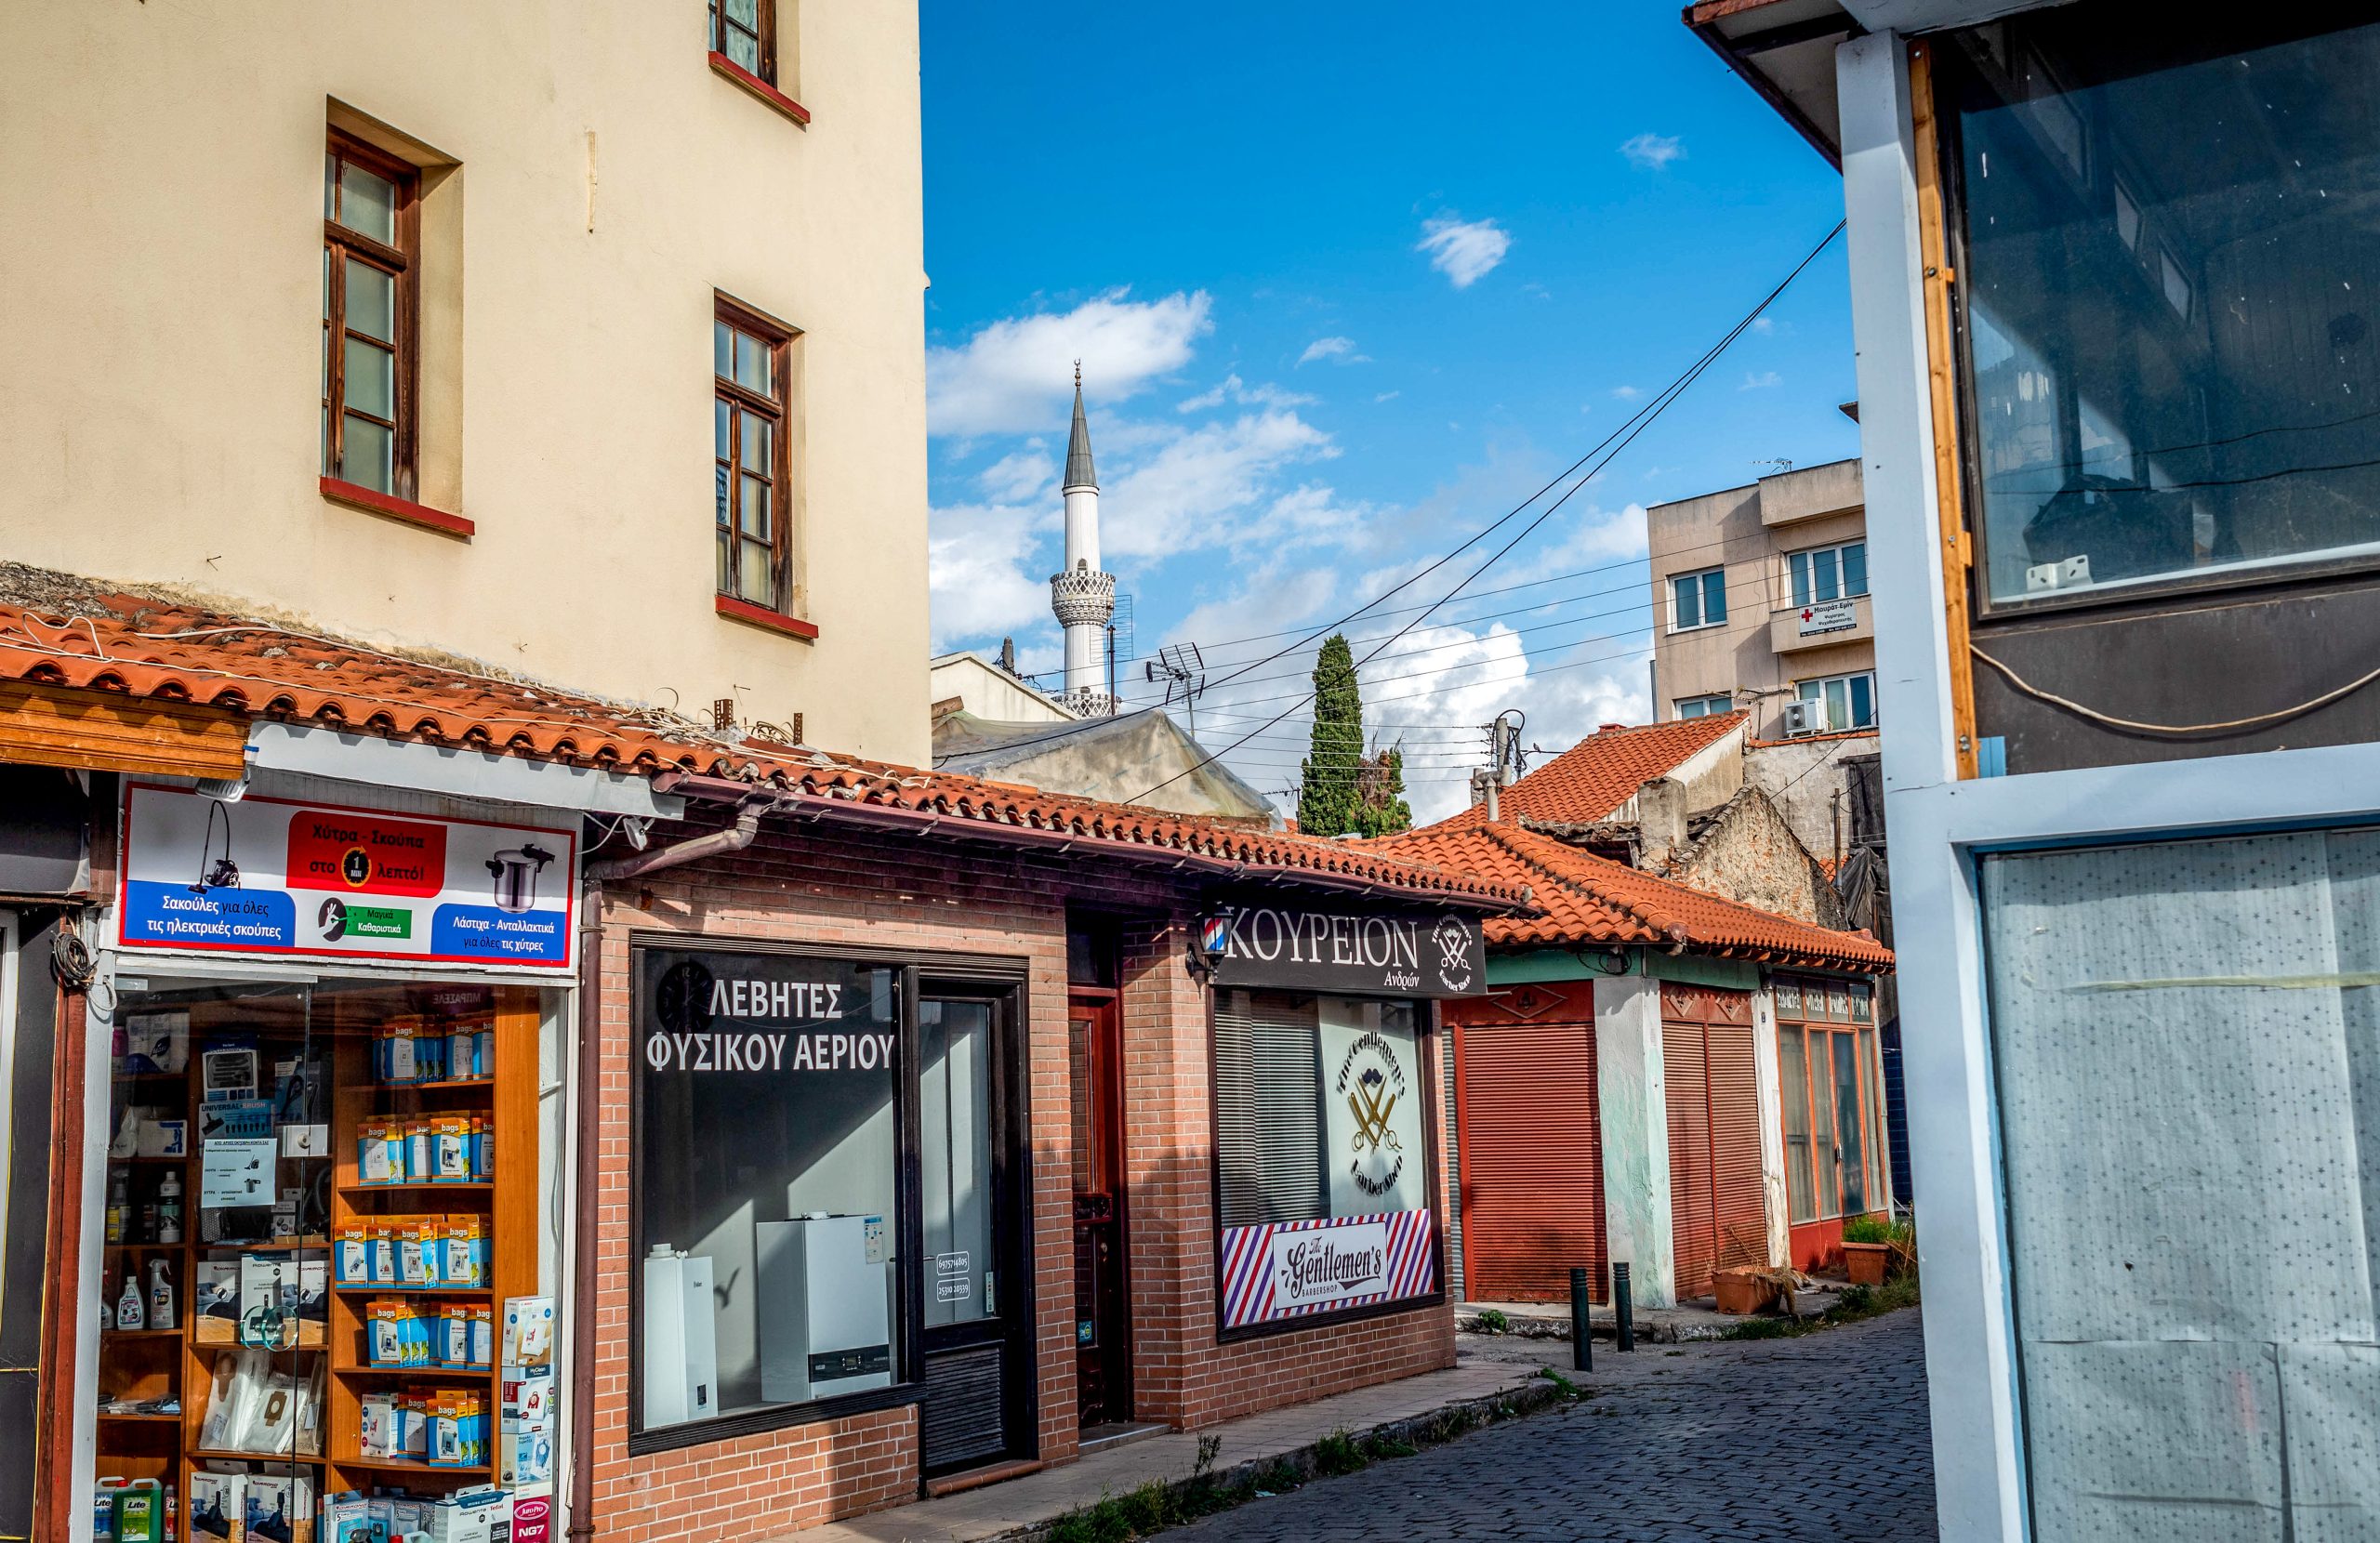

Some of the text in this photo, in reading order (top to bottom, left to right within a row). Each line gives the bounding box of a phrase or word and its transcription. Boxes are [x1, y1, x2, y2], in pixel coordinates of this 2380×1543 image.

[312, 824, 358, 843] Χύτρα
[371, 830, 425, 849] Σκούπα
[309, 861, 336, 874] στο
[377, 863, 424, 881] λεπτό!
[350, 869, 362, 877] MIN
[162, 895, 269, 917] Σακούλες για όλες
[367, 909, 394, 919] Μαγικά
[147, 918, 282, 940] τις ηλεκτρικές σκούπες
[358, 922, 402, 935] Καθαριστικά
[453, 916, 490, 931] Λάστιχα
[496, 918, 555, 934] Ανταλλακτικά
[463, 935, 544, 953] για όλες τις χύτρες
[1223, 905, 1419, 969] ΚΟΥΡΕΙΟΝ
[1383, 970, 1420, 991] Ανδρών
[708, 979, 842, 1019] ΛΕΒΗΤΕΣ
[646, 1032, 894, 1072] ΦΥΣΙΚΟΥ ΑΕΡΙΟΥ
[201, 1102, 240, 1112] UNIVERSAL
[1308, 1234, 1323, 1255] The
[938, 1257, 968, 1270] 6975714805
[1283, 1241, 1382, 1299] Gentlemen's
[938, 1284, 969, 1296] 25310 20339
[1302, 1284, 1338, 1298] BARBERSHOP
[490, 1503, 504, 1511] Tefal
[518, 1524, 545, 1537] NG7
